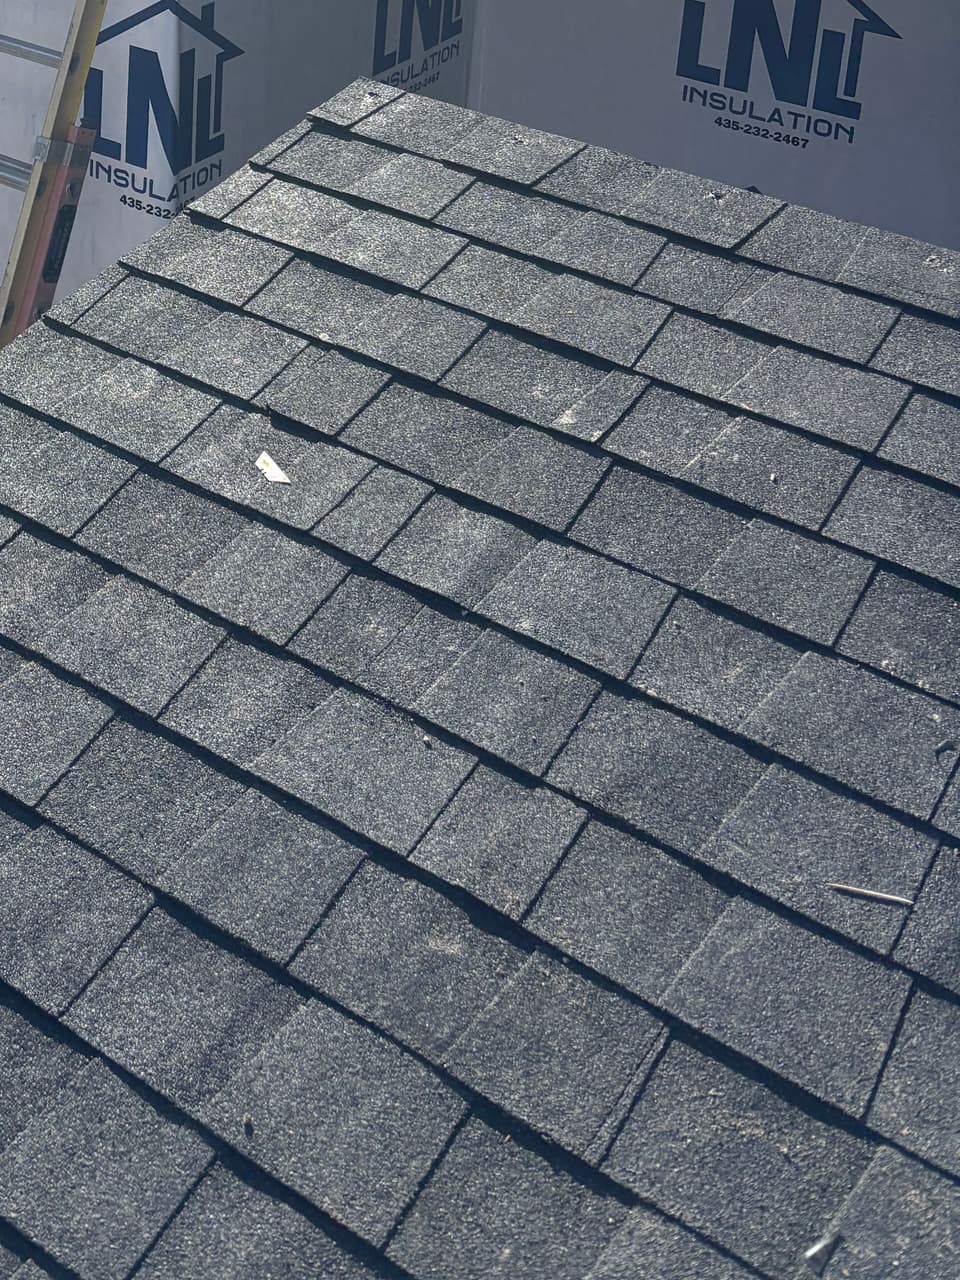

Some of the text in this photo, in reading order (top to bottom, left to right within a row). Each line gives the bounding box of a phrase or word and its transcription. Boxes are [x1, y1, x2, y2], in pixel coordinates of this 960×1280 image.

[682, 84, 855, 144] INSULATION
[713, 115, 809, 149] 435-232-2467
[90, 160, 222, 202] INSULATION
